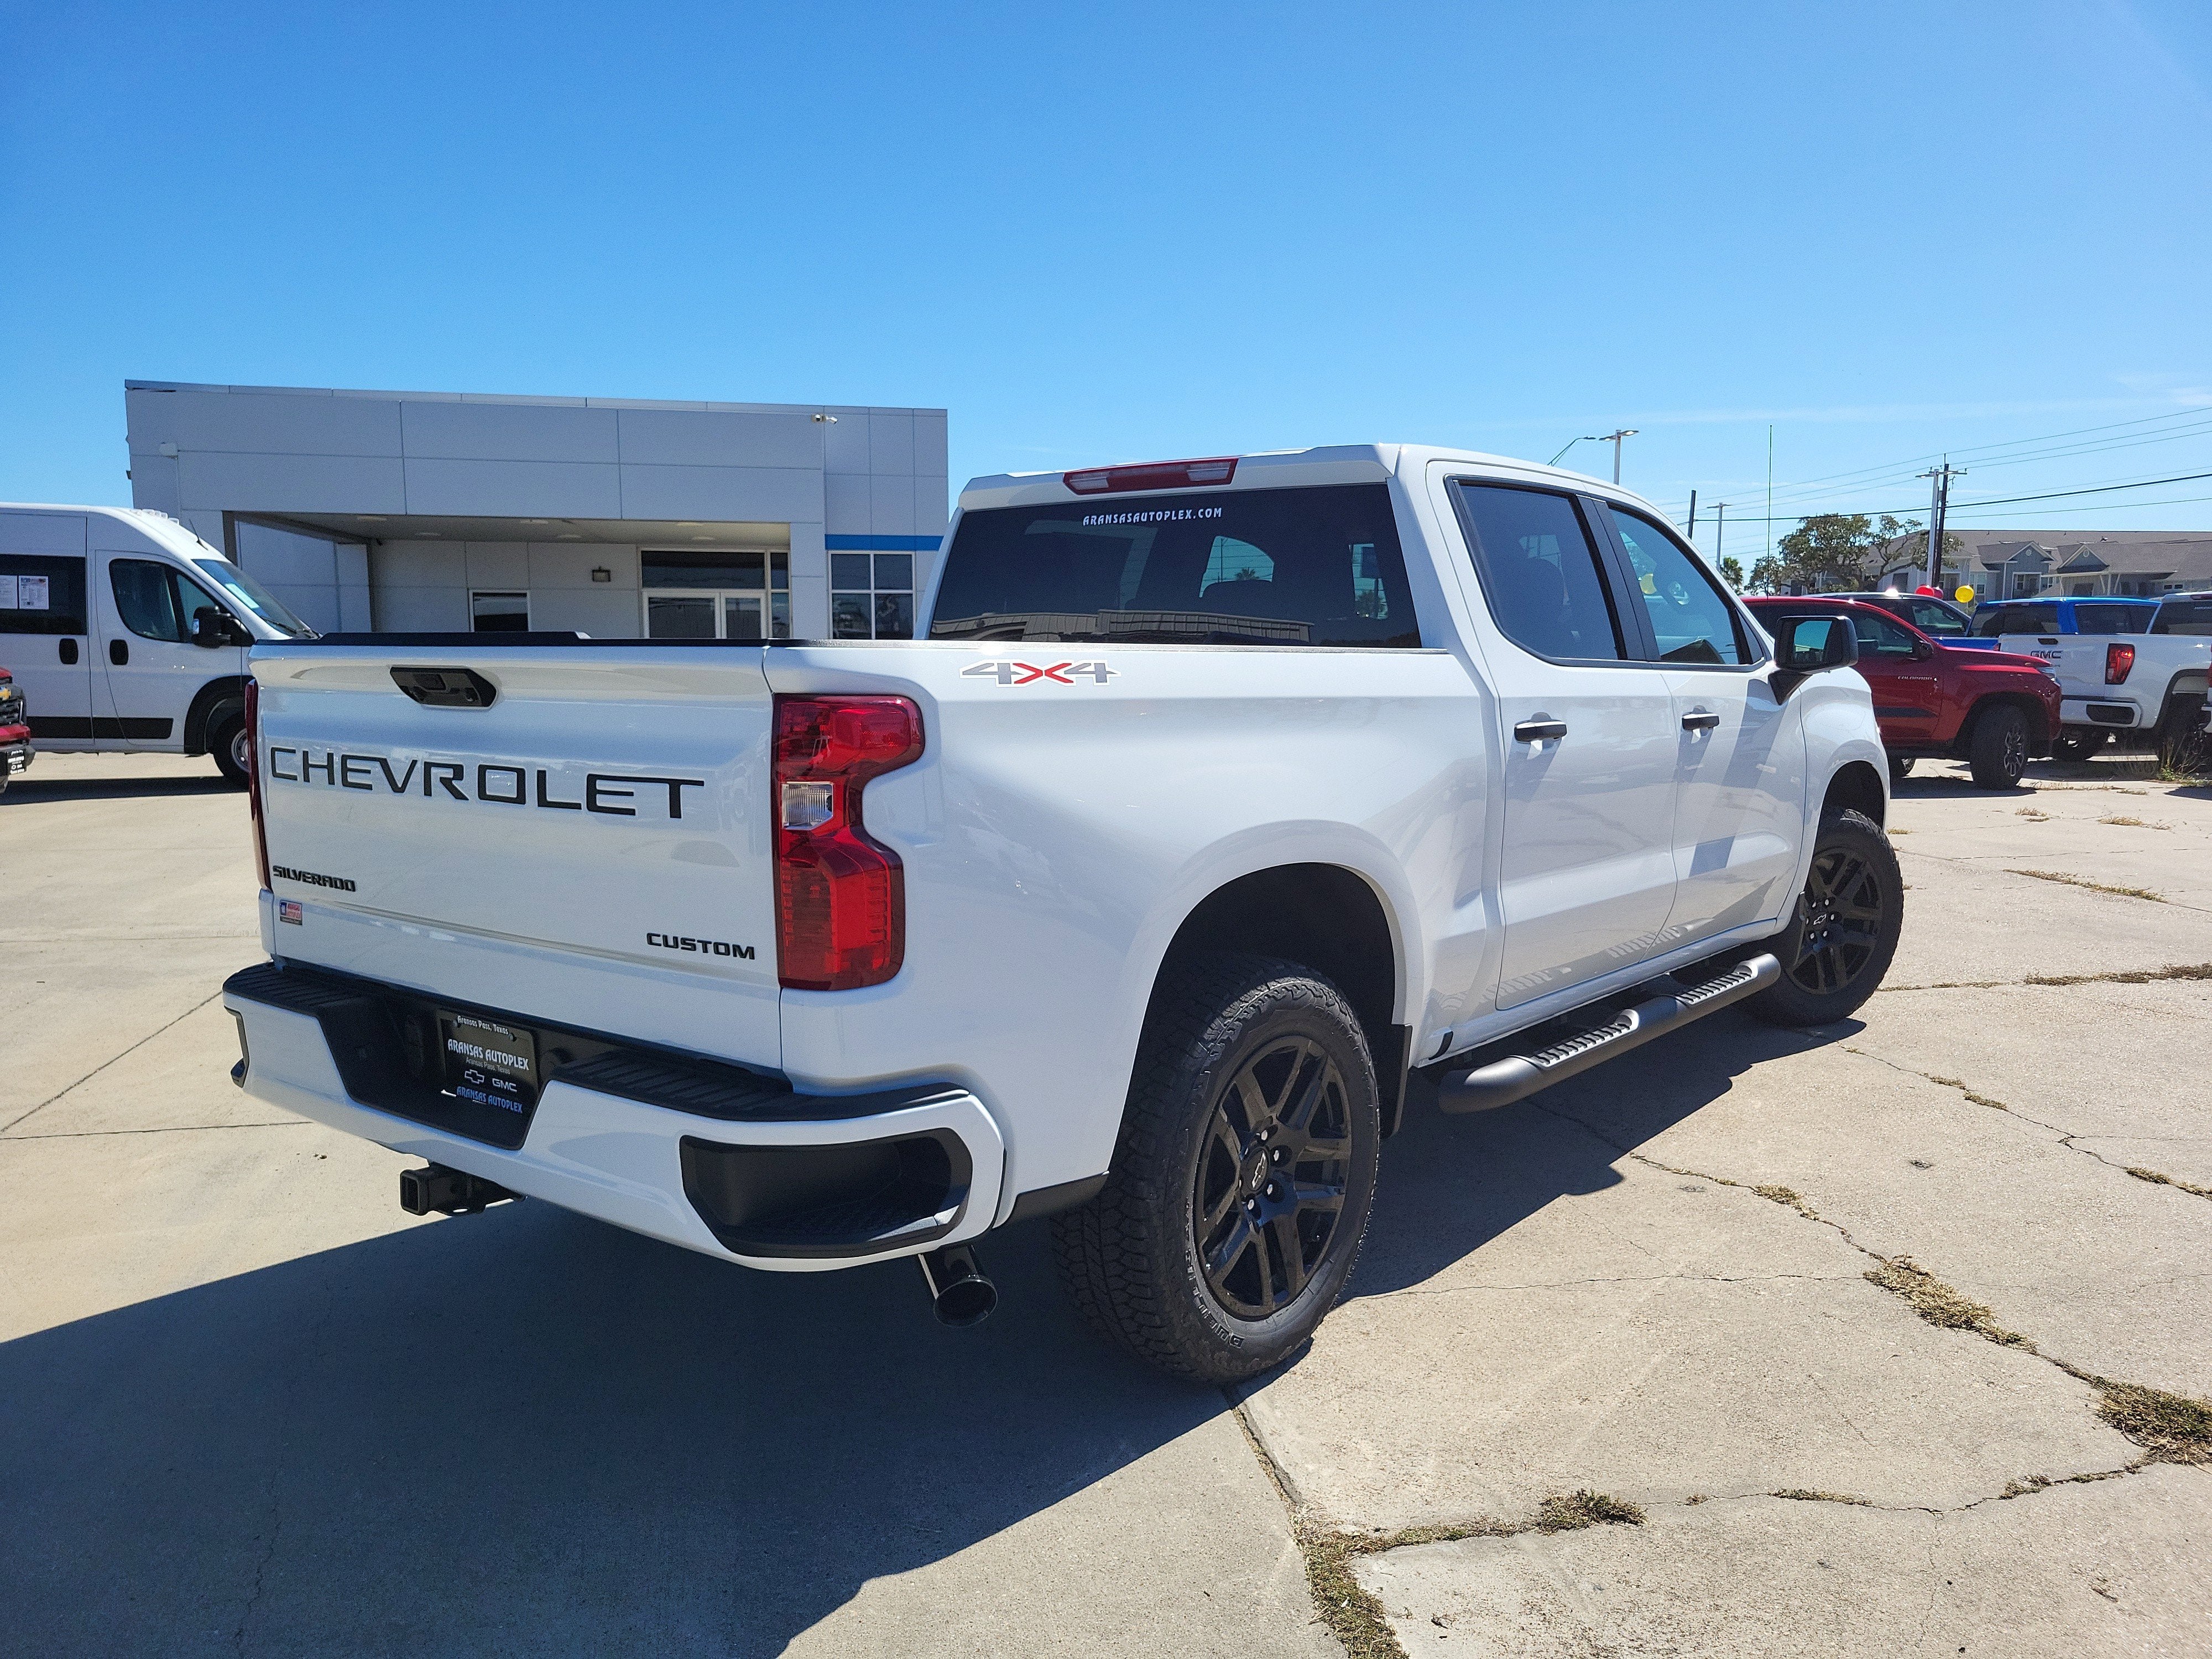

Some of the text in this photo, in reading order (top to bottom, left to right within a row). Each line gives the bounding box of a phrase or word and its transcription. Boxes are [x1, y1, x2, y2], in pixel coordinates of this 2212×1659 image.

[1083, 507, 1222, 526] ARANSASAUTOPLEX.COM
[2031, 649, 2063, 659] GMC
[270, 747, 705, 819] CHEVROLET
[273, 864, 357, 892] SILVERADO
[646, 932, 755, 960] CUSTOM
[457, 1015, 509, 1035] Aransas Pass, Texas
[447, 1039, 529, 1071] ARANSAS AUTOPLEX
[492, 1078, 518, 1093] GMC
[456, 1086, 523, 1114] ARANSAS AUTOPLEX
